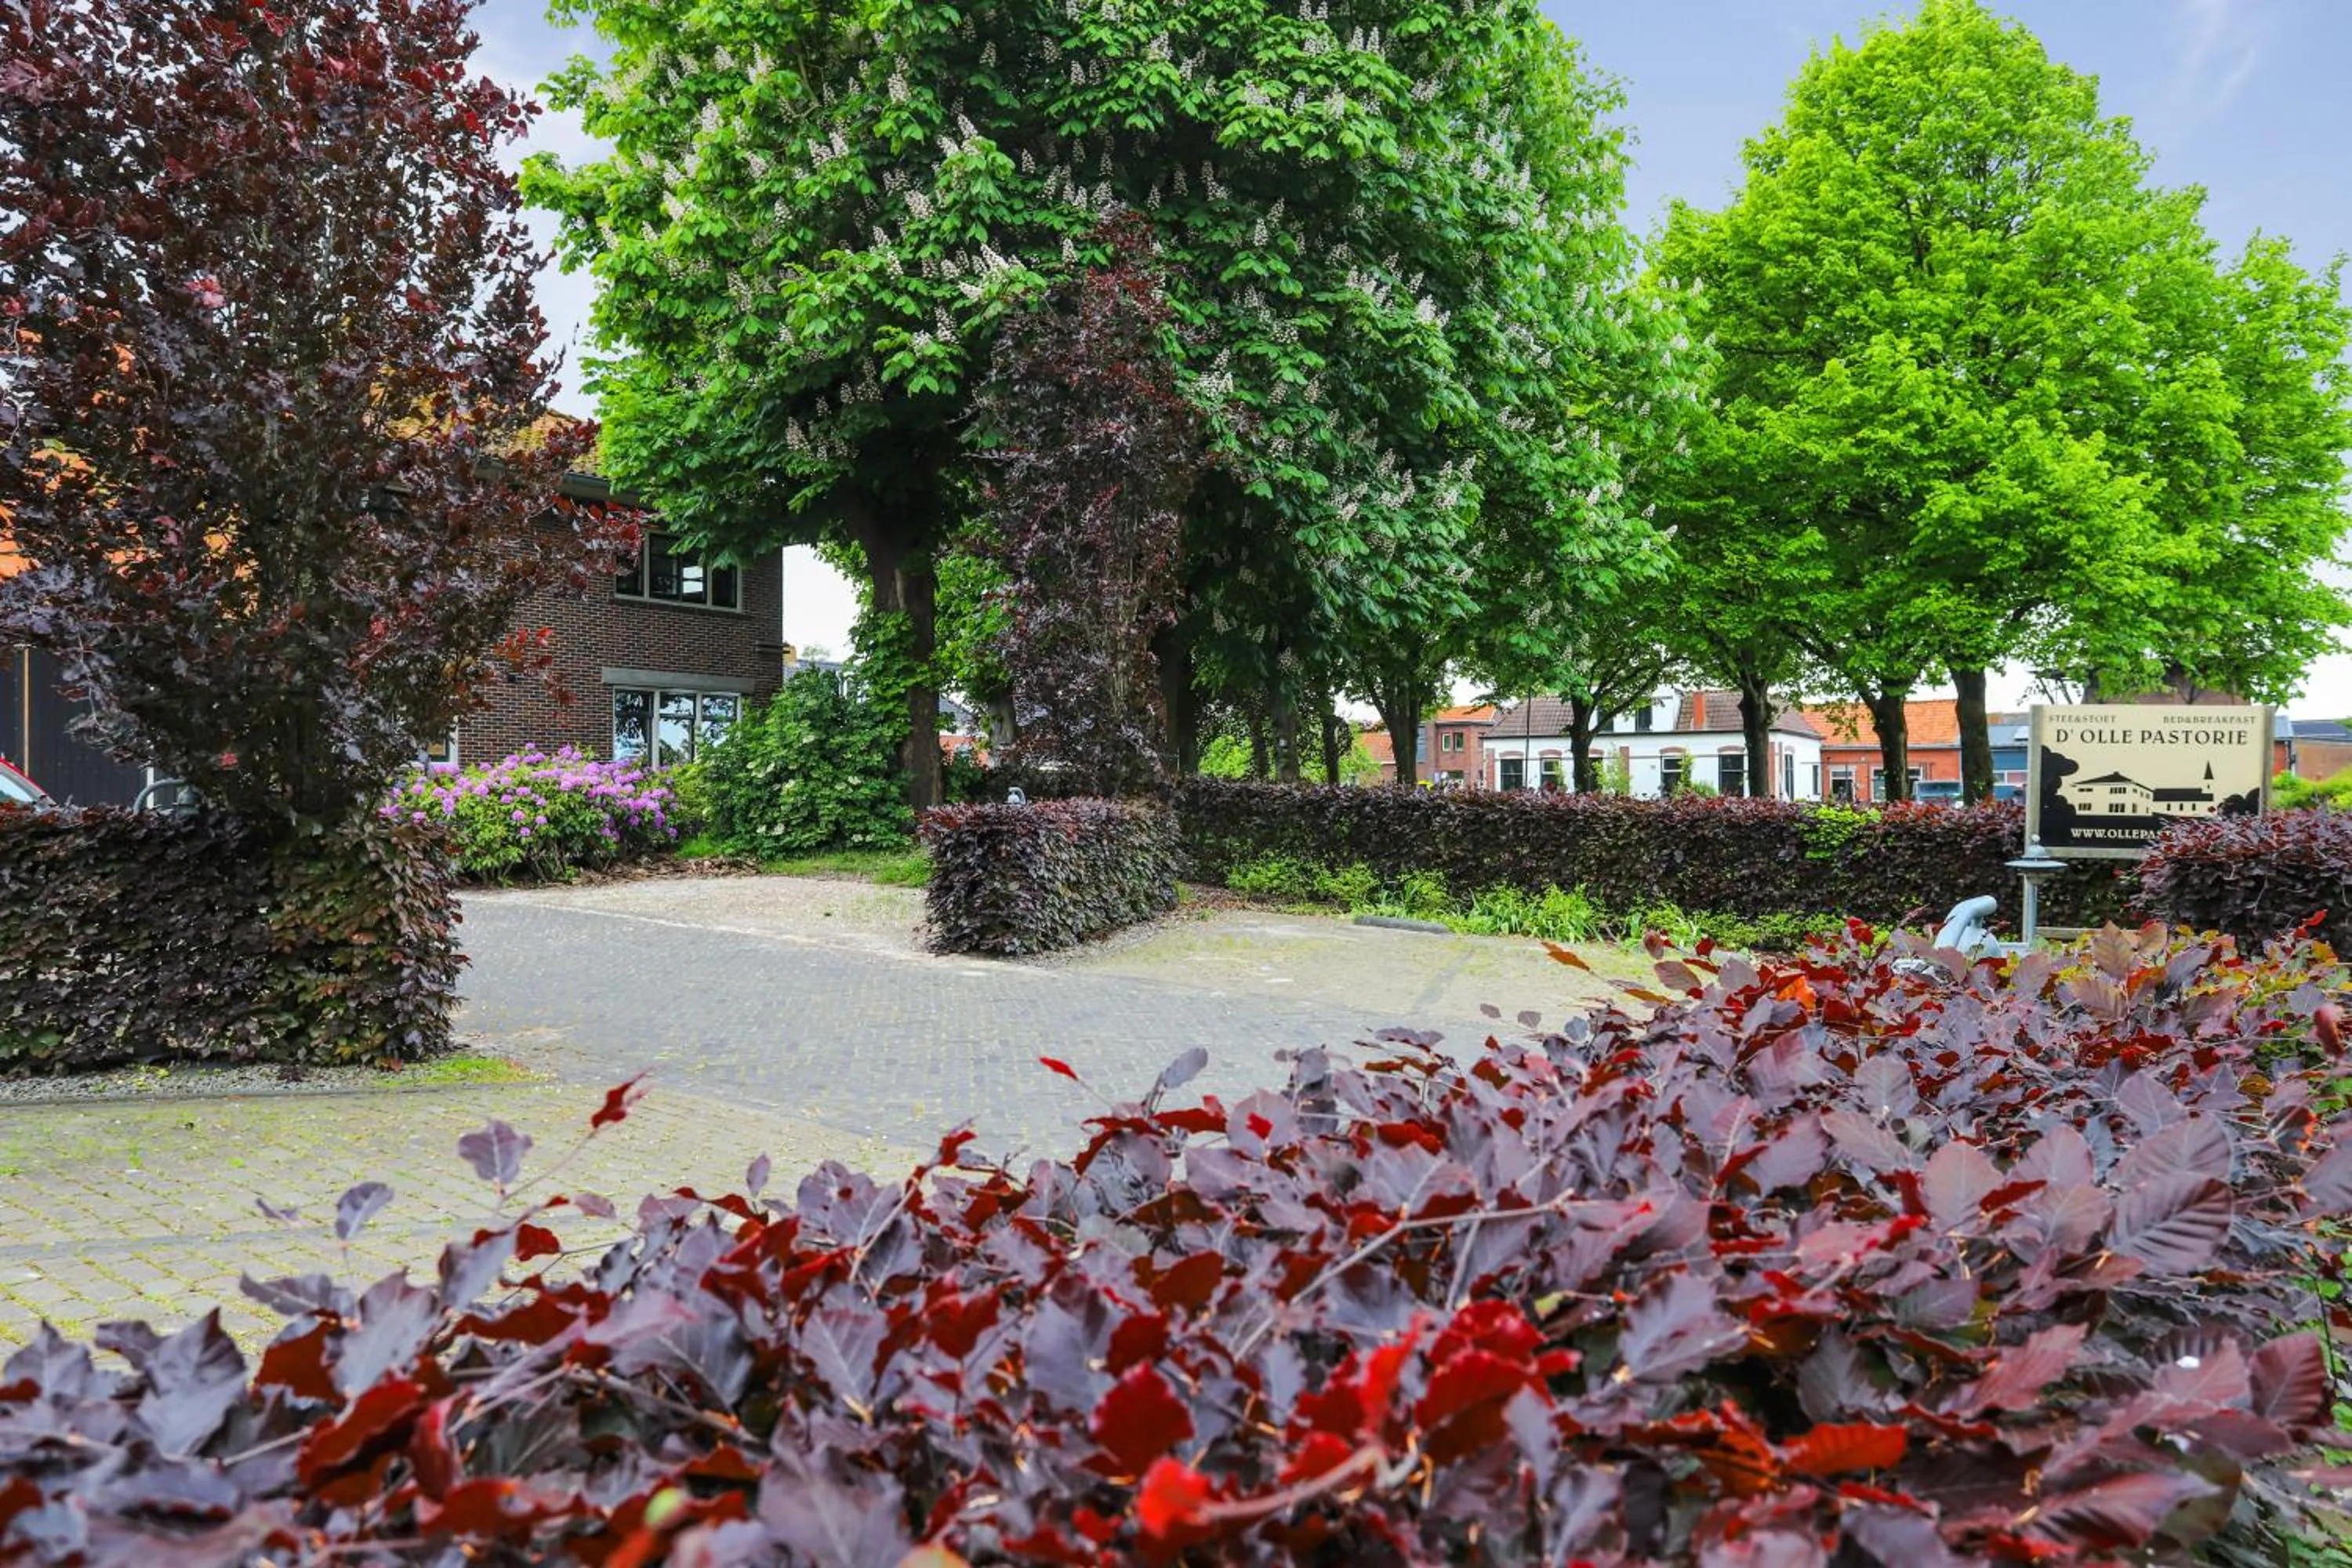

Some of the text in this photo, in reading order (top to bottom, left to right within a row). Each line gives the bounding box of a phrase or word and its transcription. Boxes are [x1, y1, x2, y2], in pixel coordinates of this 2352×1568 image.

[2080, 728, 2132, 744] OLLE
[2140, 730, 2248, 745] PASTORIE
[2070, 828, 2172, 840] WWW.OLLEPA
